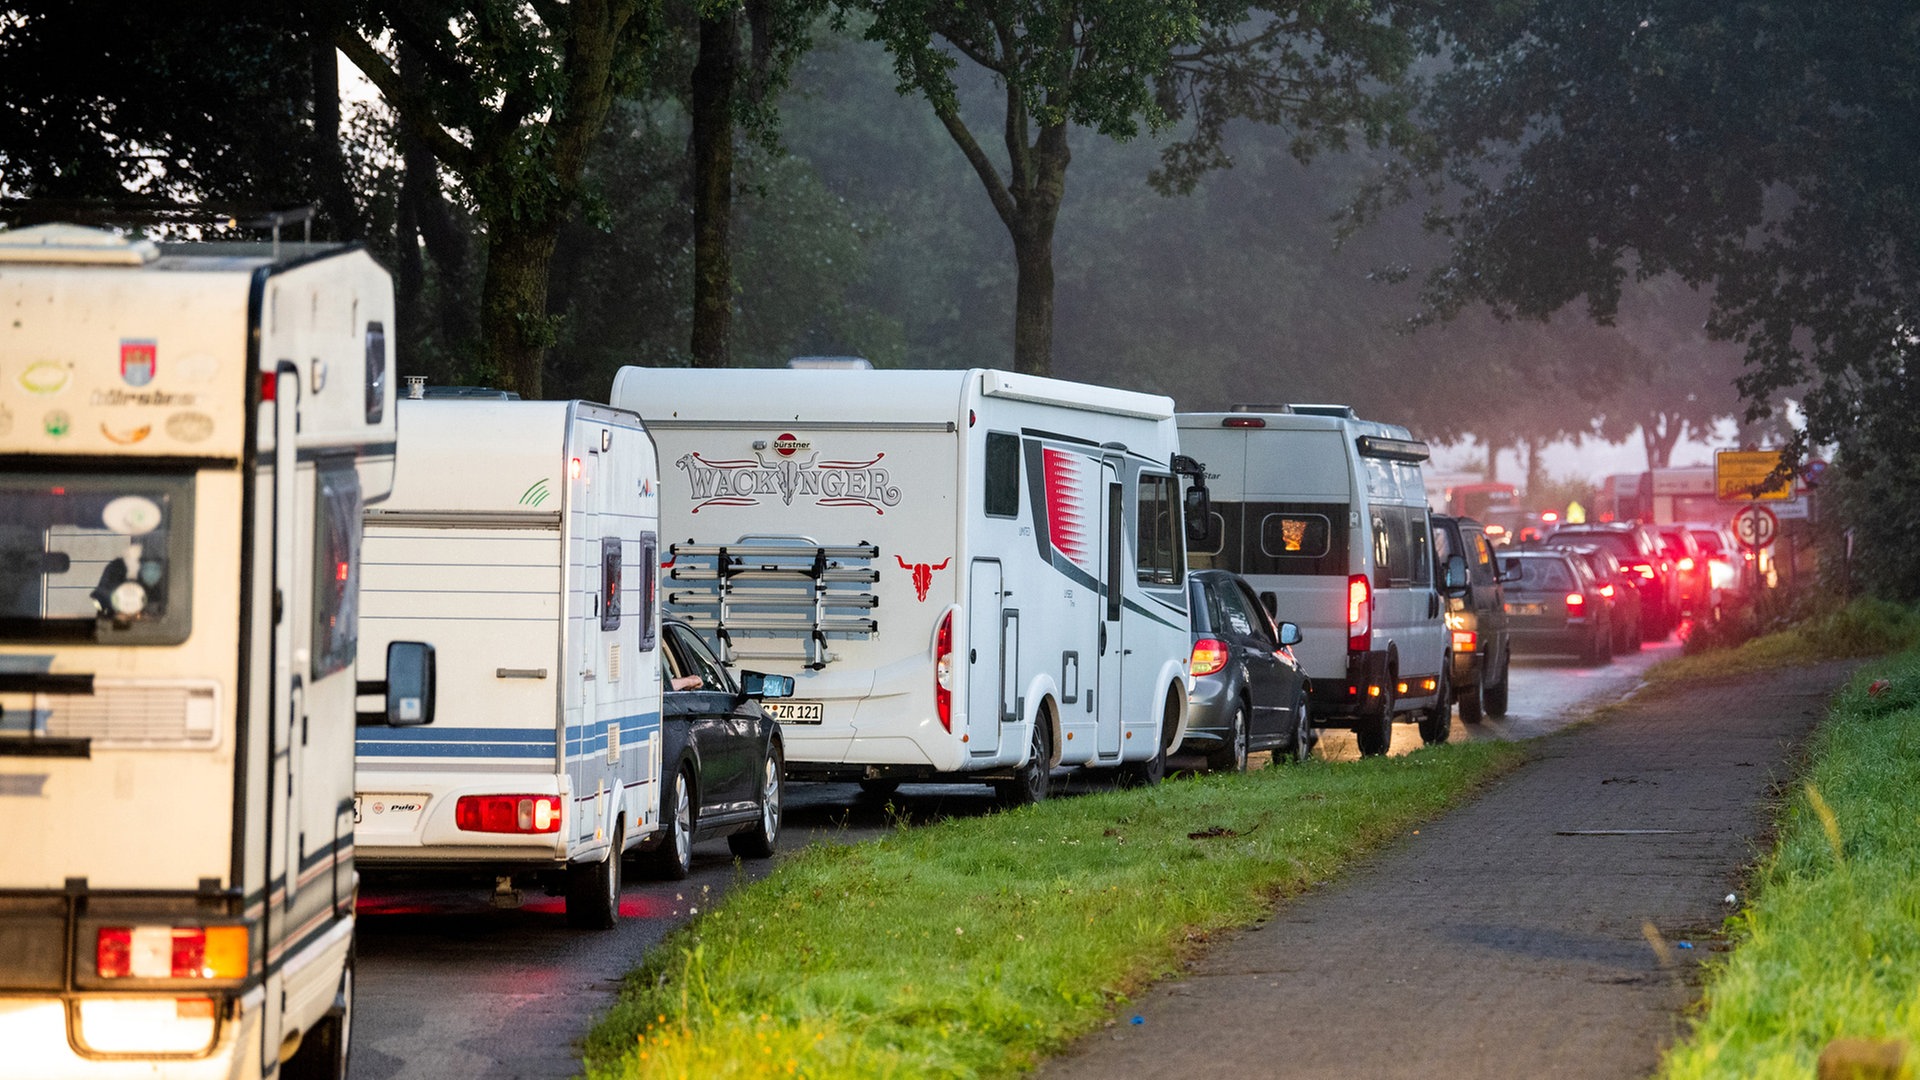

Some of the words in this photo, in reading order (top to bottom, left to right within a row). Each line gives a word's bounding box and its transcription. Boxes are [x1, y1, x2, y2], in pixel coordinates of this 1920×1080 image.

[773, 440, 810, 448] bürstner
[1742, 517, 1769, 537] 30
[779, 705, 794, 718] ZR
[797, 705, 819, 719] 121
